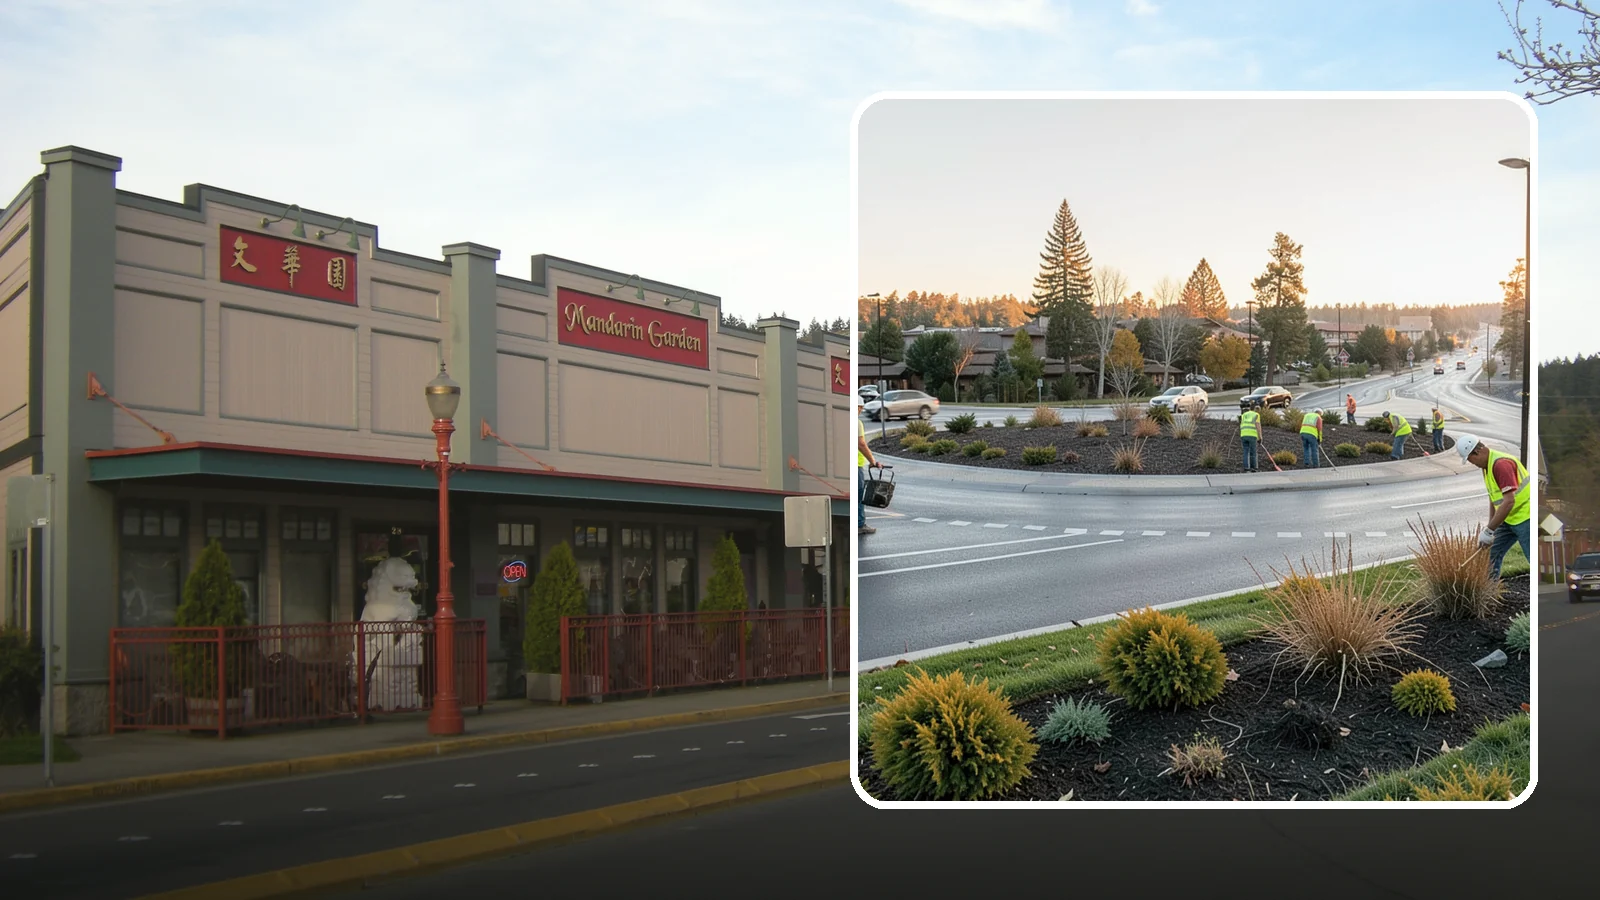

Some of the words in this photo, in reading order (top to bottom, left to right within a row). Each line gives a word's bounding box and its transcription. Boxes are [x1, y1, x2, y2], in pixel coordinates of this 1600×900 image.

[230, 235, 346, 292] 文華園
[565, 302, 644, 341] Mandarin
[648, 320, 702, 353] Garden
[503, 565, 527, 578] OPEN
